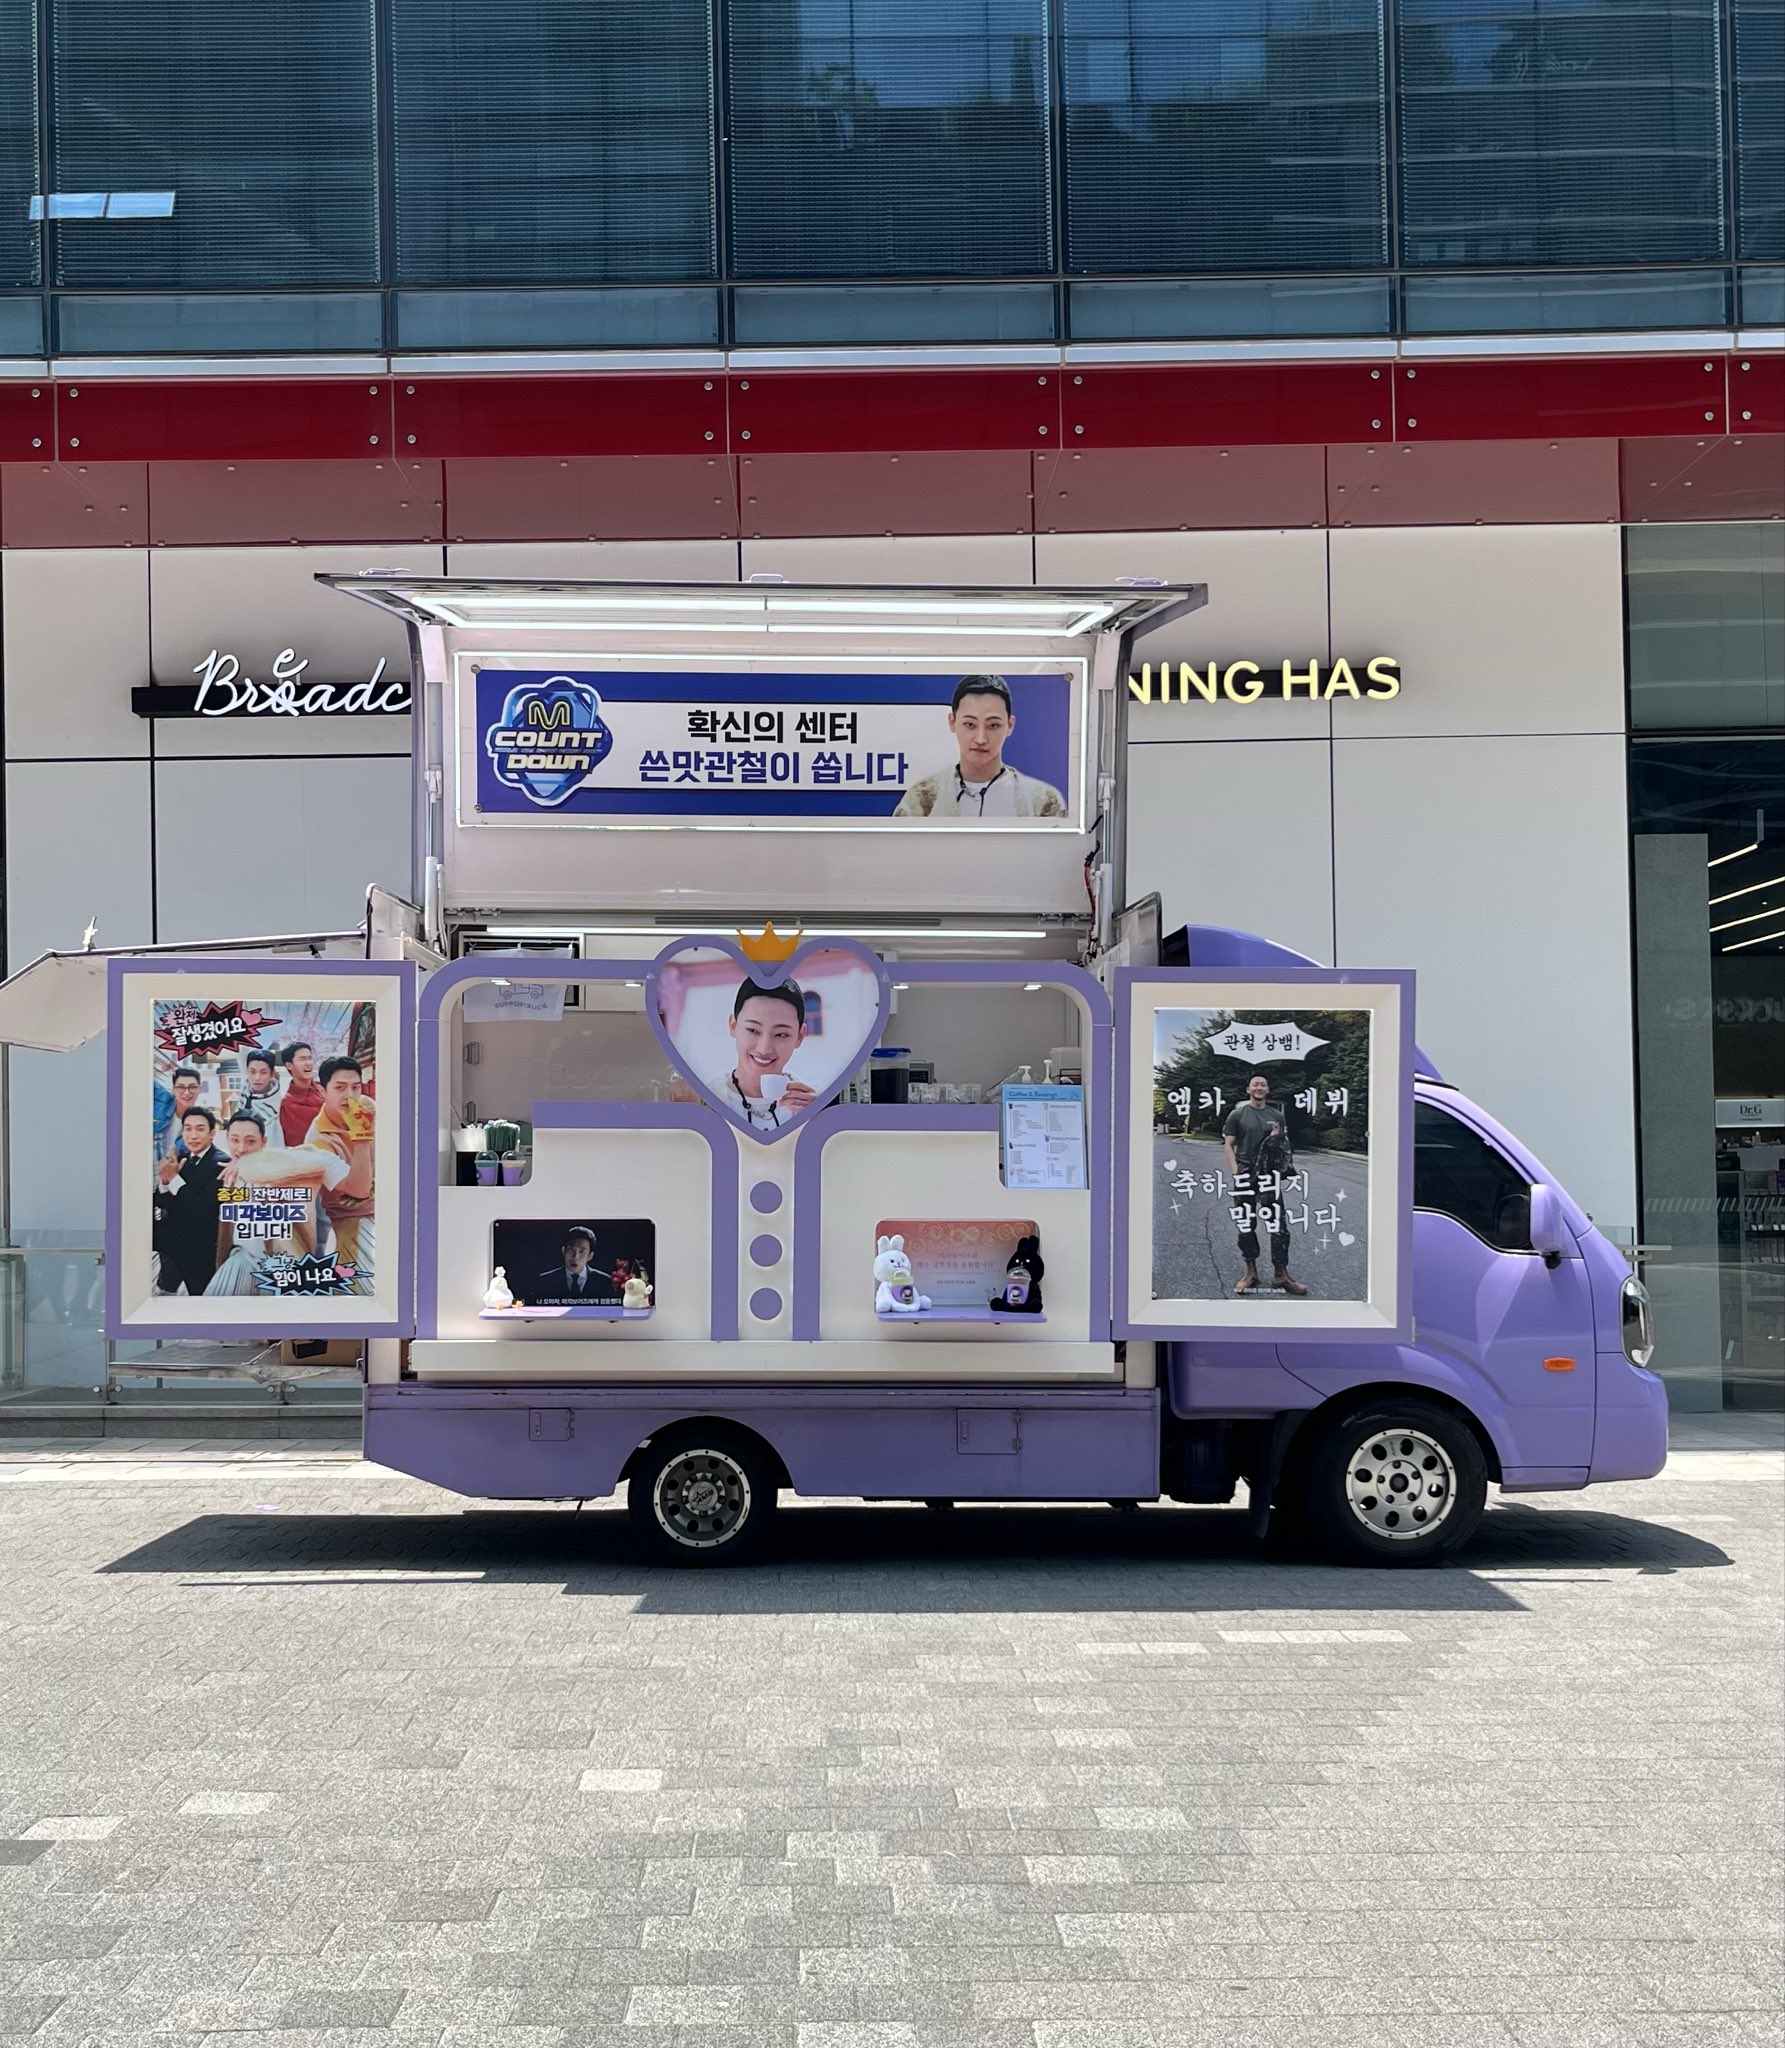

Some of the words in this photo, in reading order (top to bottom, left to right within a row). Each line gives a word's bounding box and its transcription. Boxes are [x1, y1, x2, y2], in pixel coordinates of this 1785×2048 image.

[1282, 656, 1400, 701] HAS
[687, 710, 783, 744] 확신의
[795, 710, 858, 745] 센터
[639, 751, 800, 785] 쓴맛관철이
[811, 751, 909, 785] 쏩니다
[173, 1009, 197, 1025] 완전
[171, 1016, 247, 1046] 잘생겼어요
[1223, 1034, 1255, 1051] 관철
[1167, 1086, 1226, 1117] 엠카
[1294, 1086, 1349, 1117] 데뷔
[217, 1187, 249, 1201] 충성!
[252, 1187, 312, 1201] 잔반제로!
[1170, 1169, 1309, 1200] 축하드리지
[222, 1204, 307, 1222] 미각보이즈
[1228, 1203, 1341, 1234] 말입니다
[236, 1222, 292, 1239] 입니다!
[272, 1257, 293, 1269] 그냥
[273, 1269, 302, 1287] 힘이
[305, 1267, 337, 1285] 나요
